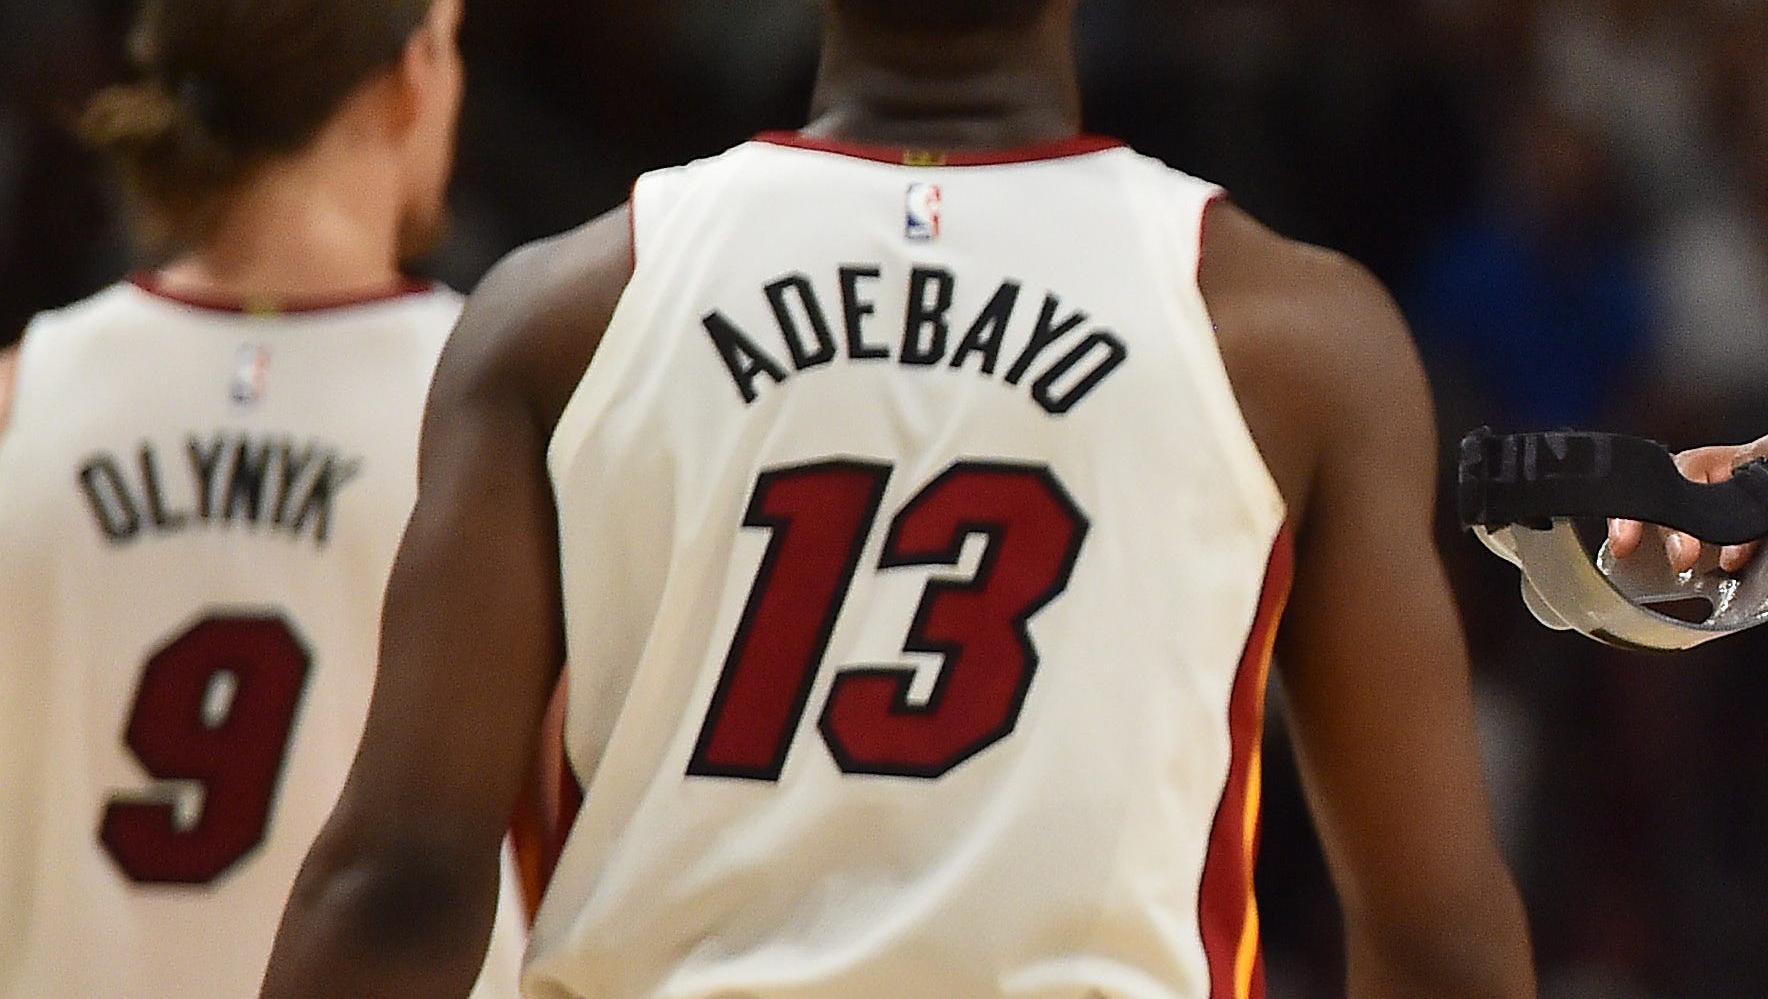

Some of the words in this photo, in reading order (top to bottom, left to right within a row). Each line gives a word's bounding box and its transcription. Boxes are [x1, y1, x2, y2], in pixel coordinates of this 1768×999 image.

[702, 262, 1129, 416] ADEBAYO
[75, 429, 364, 549] OLYNYK
[686, 455, 1090, 783] 13
[97, 603, 315, 892] 9
